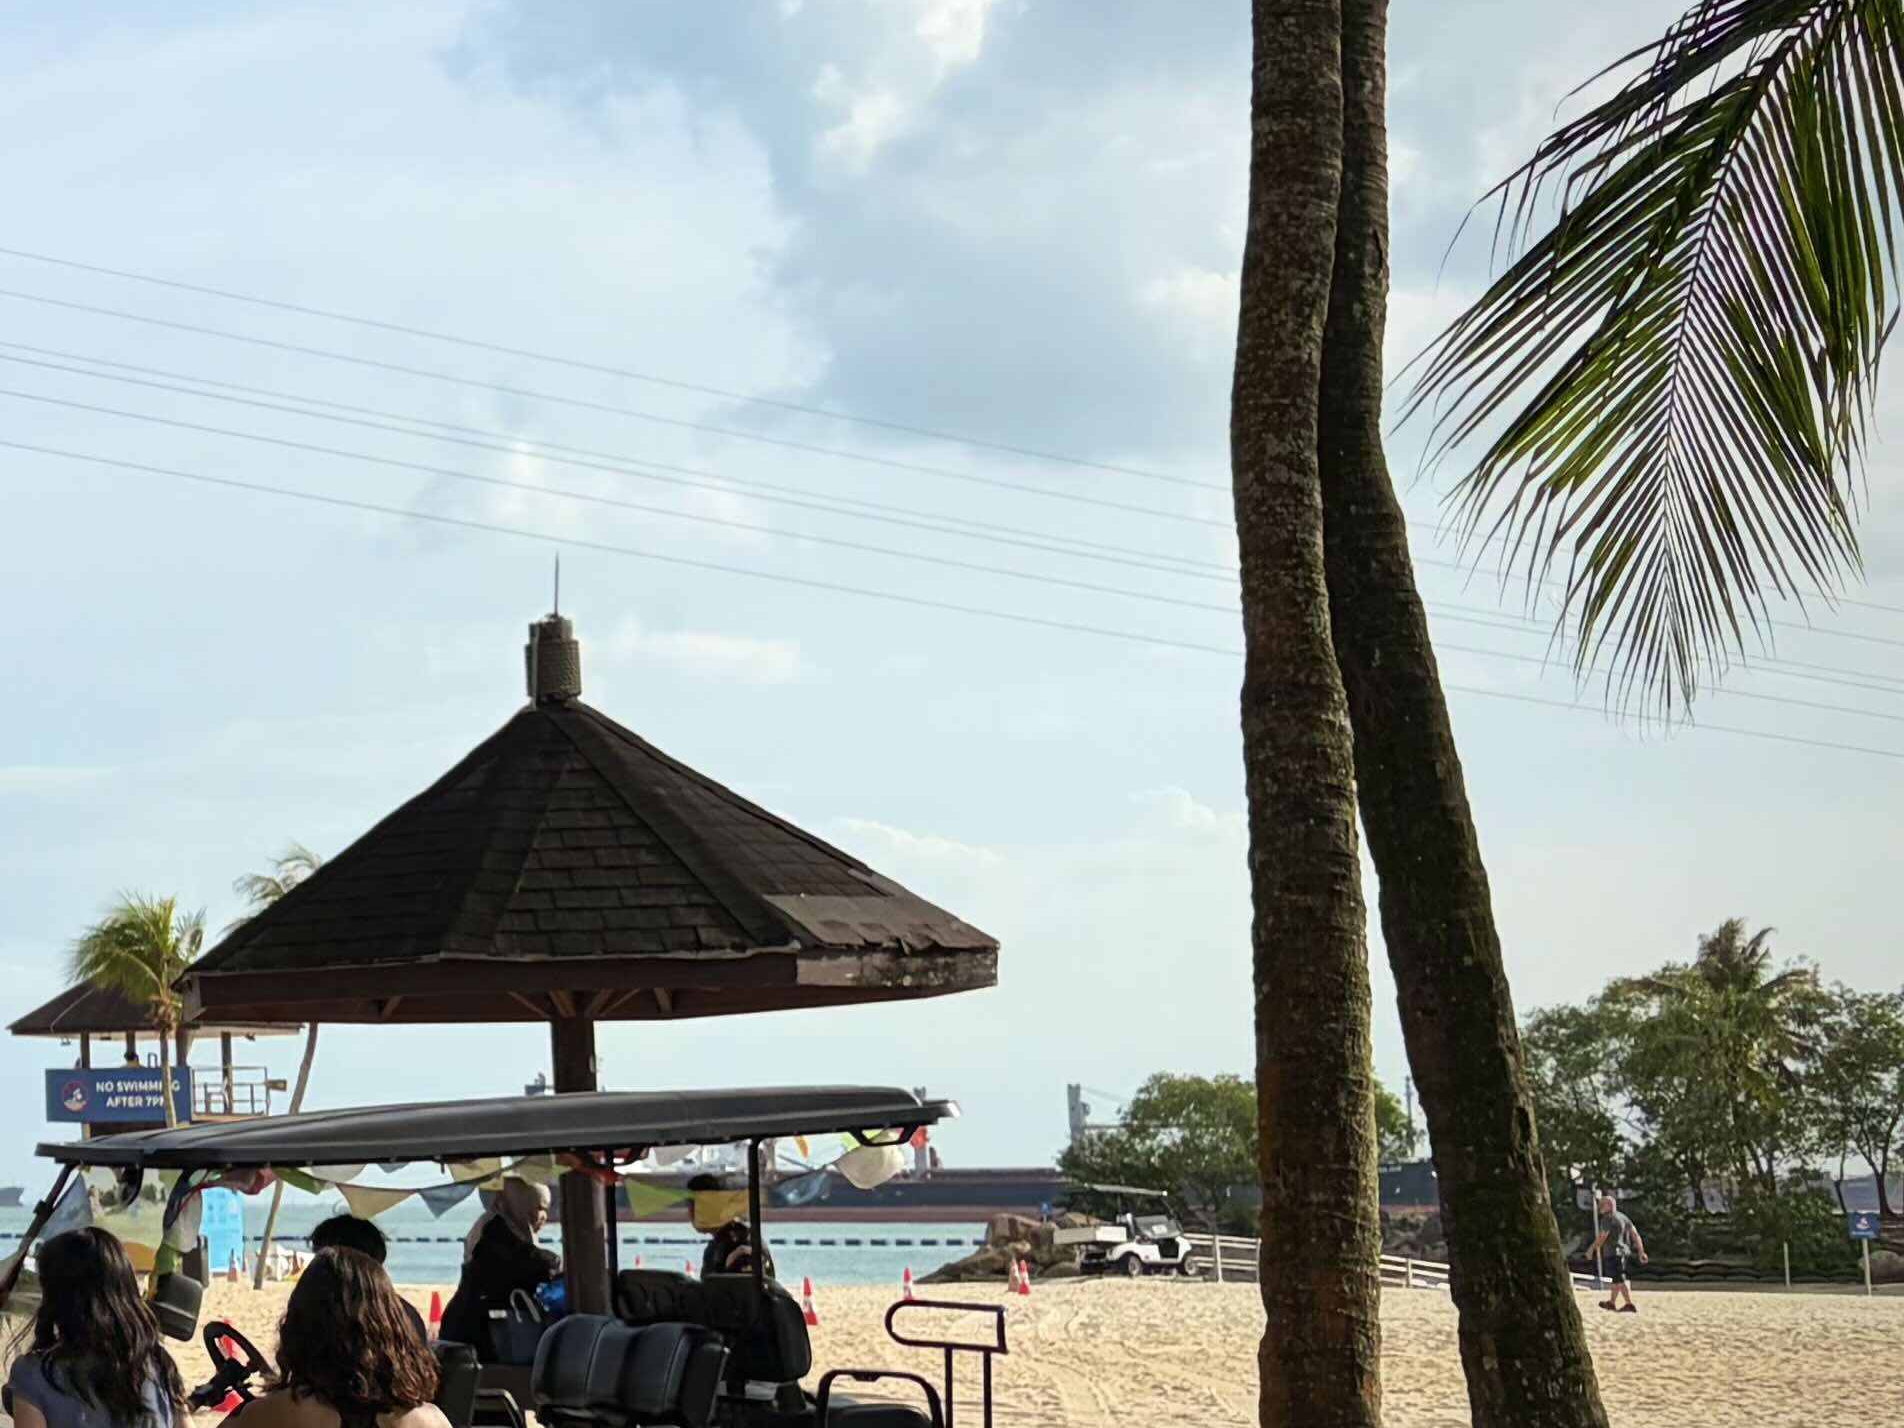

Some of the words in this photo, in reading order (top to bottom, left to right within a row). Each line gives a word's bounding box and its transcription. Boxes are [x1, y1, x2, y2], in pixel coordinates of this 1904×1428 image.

[95, 1080, 114, 1092] NO
[116, 1079, 181, 1092] SWIMMIG
[106, 1096, 143, 1108] AFTER
